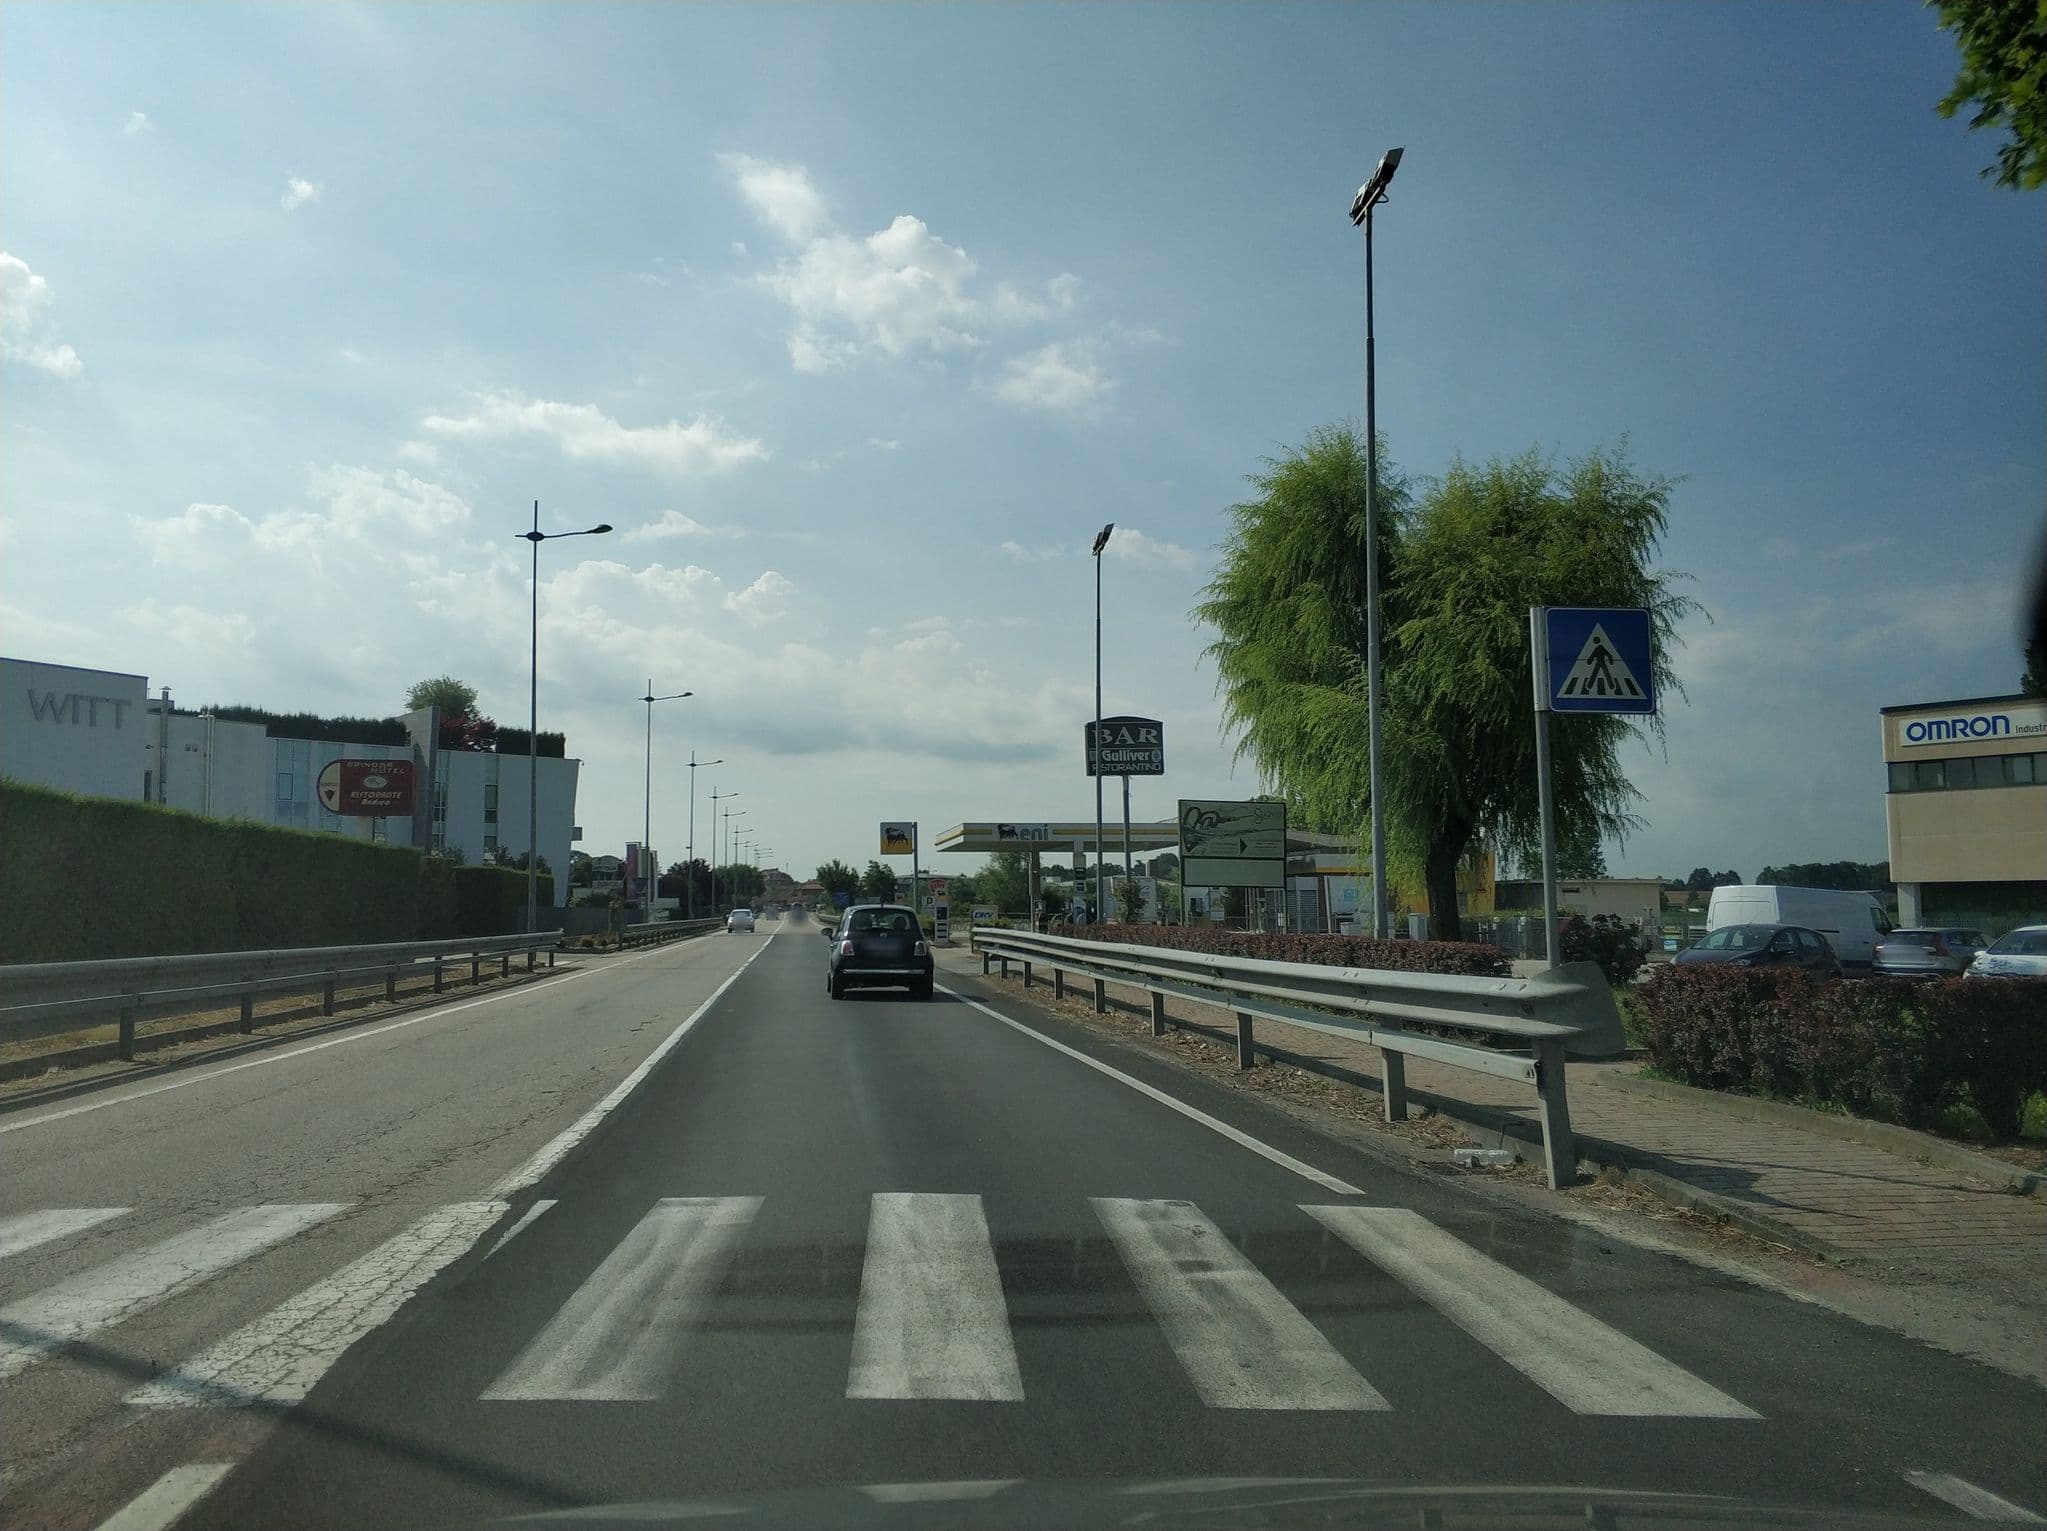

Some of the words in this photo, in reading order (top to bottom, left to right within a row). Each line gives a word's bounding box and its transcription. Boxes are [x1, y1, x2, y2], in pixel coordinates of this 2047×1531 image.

[28, 689, 132, 730] WITT
[1092, 727, 1159, 745] BAR
[1102, 750, 1150, 762] Gulliver
[1092, 763, 1162, 772] RSTORANTINO
[1020, 824, 1048, 841] eni
